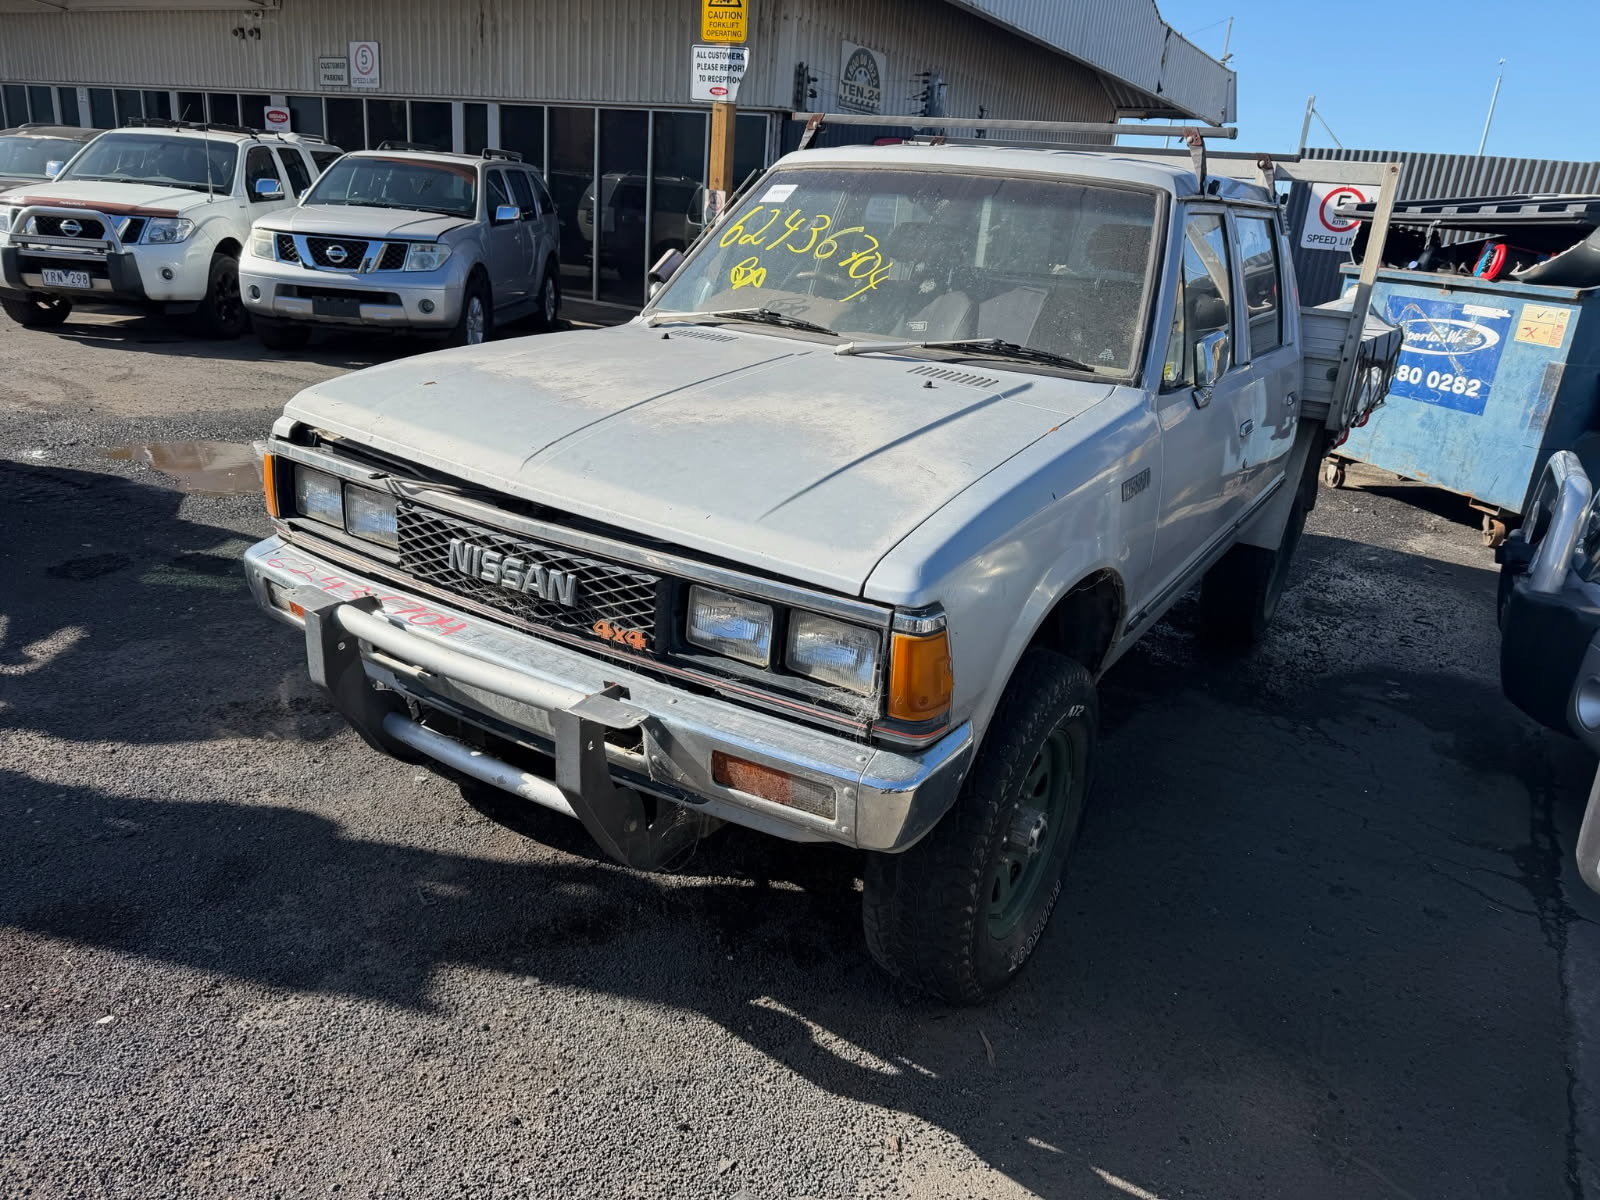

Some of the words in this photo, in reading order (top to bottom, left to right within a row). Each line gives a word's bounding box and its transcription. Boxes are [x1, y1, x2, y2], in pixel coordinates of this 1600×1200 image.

[708, 11, 742, 19] CAUTION
[706, 29, 742, 37] OPERATING
[361, 49, 368, 65] 5
[696, 51, 706, 59] ALL
[708, 51, 744, 60] CUSTOMERS
[697, 62, 718, 71] PLEASE
[699, 74, 706, 82] TO
[707, 75, 741, 84] RECEPTION
[1306, 234, 1337, 245] SPEED
[44, 271, 63, 282] YRN
[71, 273, 88, 285] 298
[1426, 371, 1482, 398] 0282
[450, 538, 577, 607] NISSAN
[592, 619, 647, 650] 4x4
